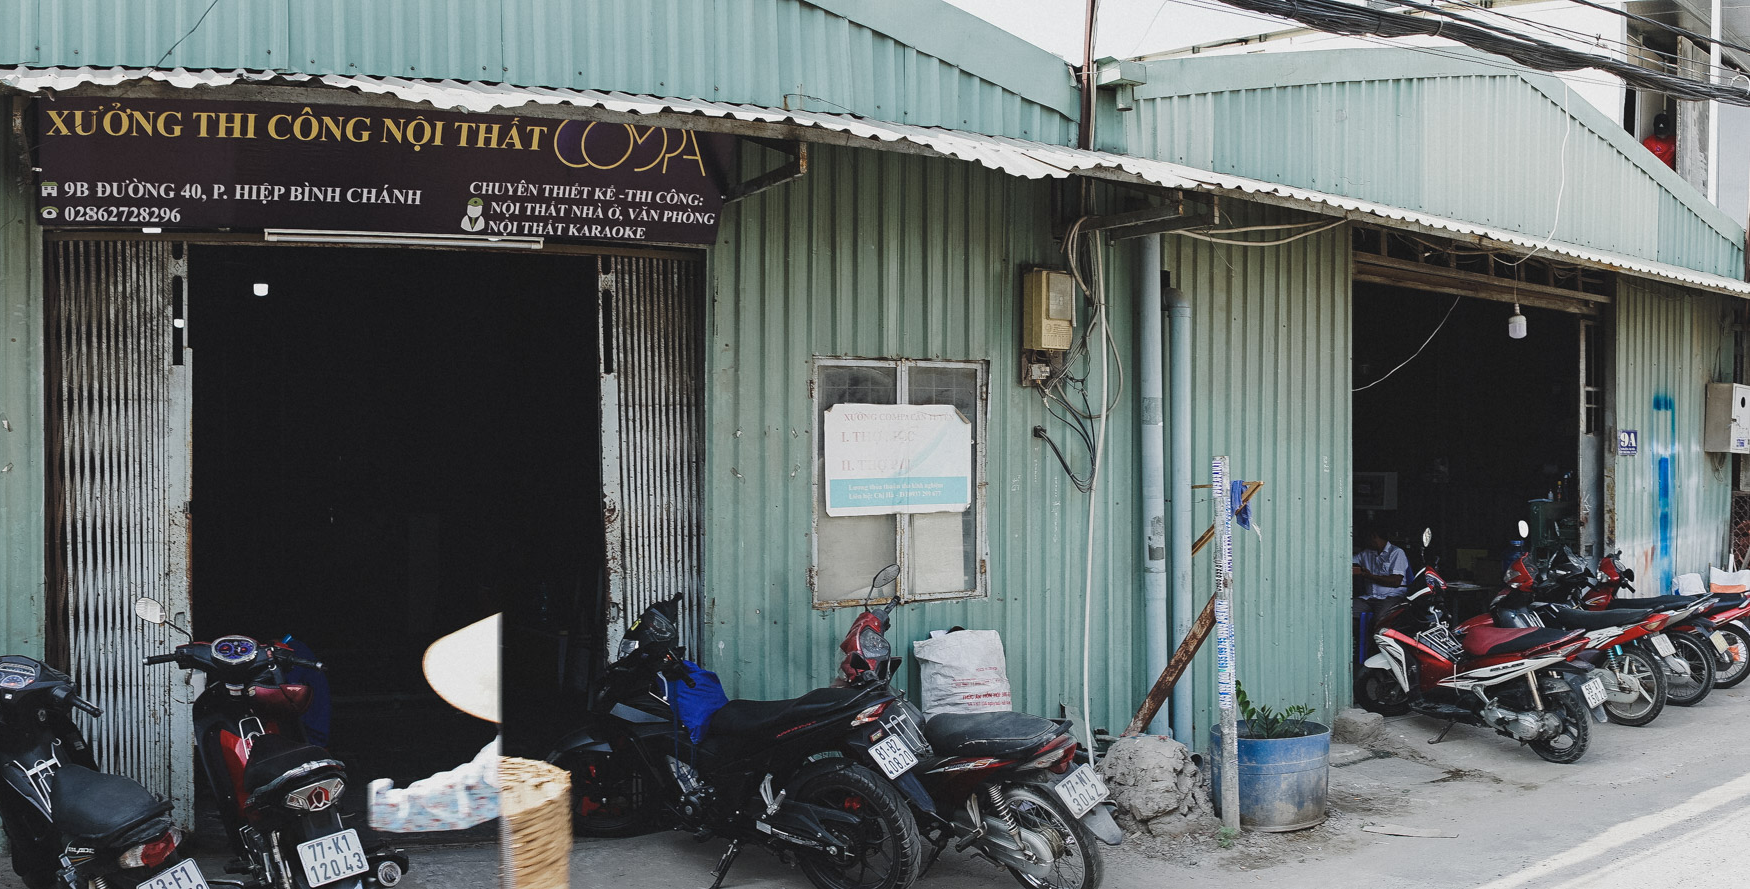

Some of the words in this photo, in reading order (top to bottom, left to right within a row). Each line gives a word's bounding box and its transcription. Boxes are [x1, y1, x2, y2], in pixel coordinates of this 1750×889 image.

[46, 102, 184, 138] XƯỞNG
[192, 112, 257, 139] THI
[267, 106, 372, 143] CÔNG
[380, 116, 445, 151] NỘI
[454, 117, 548, 151] THẤT
[64, 182, 89, 198] 9B
[96, 178, 175, 199] ĐƯỜNG
[181, 183, 207, 202] 40,
[212, 184, 228, 200] P.
[235, 182, 286, 204] HIỆP
[290, 182, 341, 203] BÌNH
[346, 184, 422, 205] CHÁNH
[469, 180, 538, 198] CHUYÊN
[543, 181, 592, 200] THIẾT
[595, 184, 616, 201] KẾ
[655, 188, 704, 206] CÔNG:
[64, 206, 181, 223] 02862728296
[490, 201, 522, 219] NỘI
[525, 200, 569, 217] THẤT
[571, 203, 605, 219] NHÀ
[607, 203, 623, 221] Ở,
[627, 207, 660, 222] VĂN
[663, 208, 716, 225] PHÒNG
[488, 219, 520, 236] NỘI
[522, 220, 570, 236] THẤT
[571, 223, 647, 239] KARAOKE
[1620, 432, 1636, 447] 9A
[884, 750, 914, 775] 408.20
[1062, 769, 1091, 797] 77-N1
[1072, 783, 1104, 811] 3042
[307, 834, 351, 862] 77-K1
[311, 852, 364, 883] 120.43
